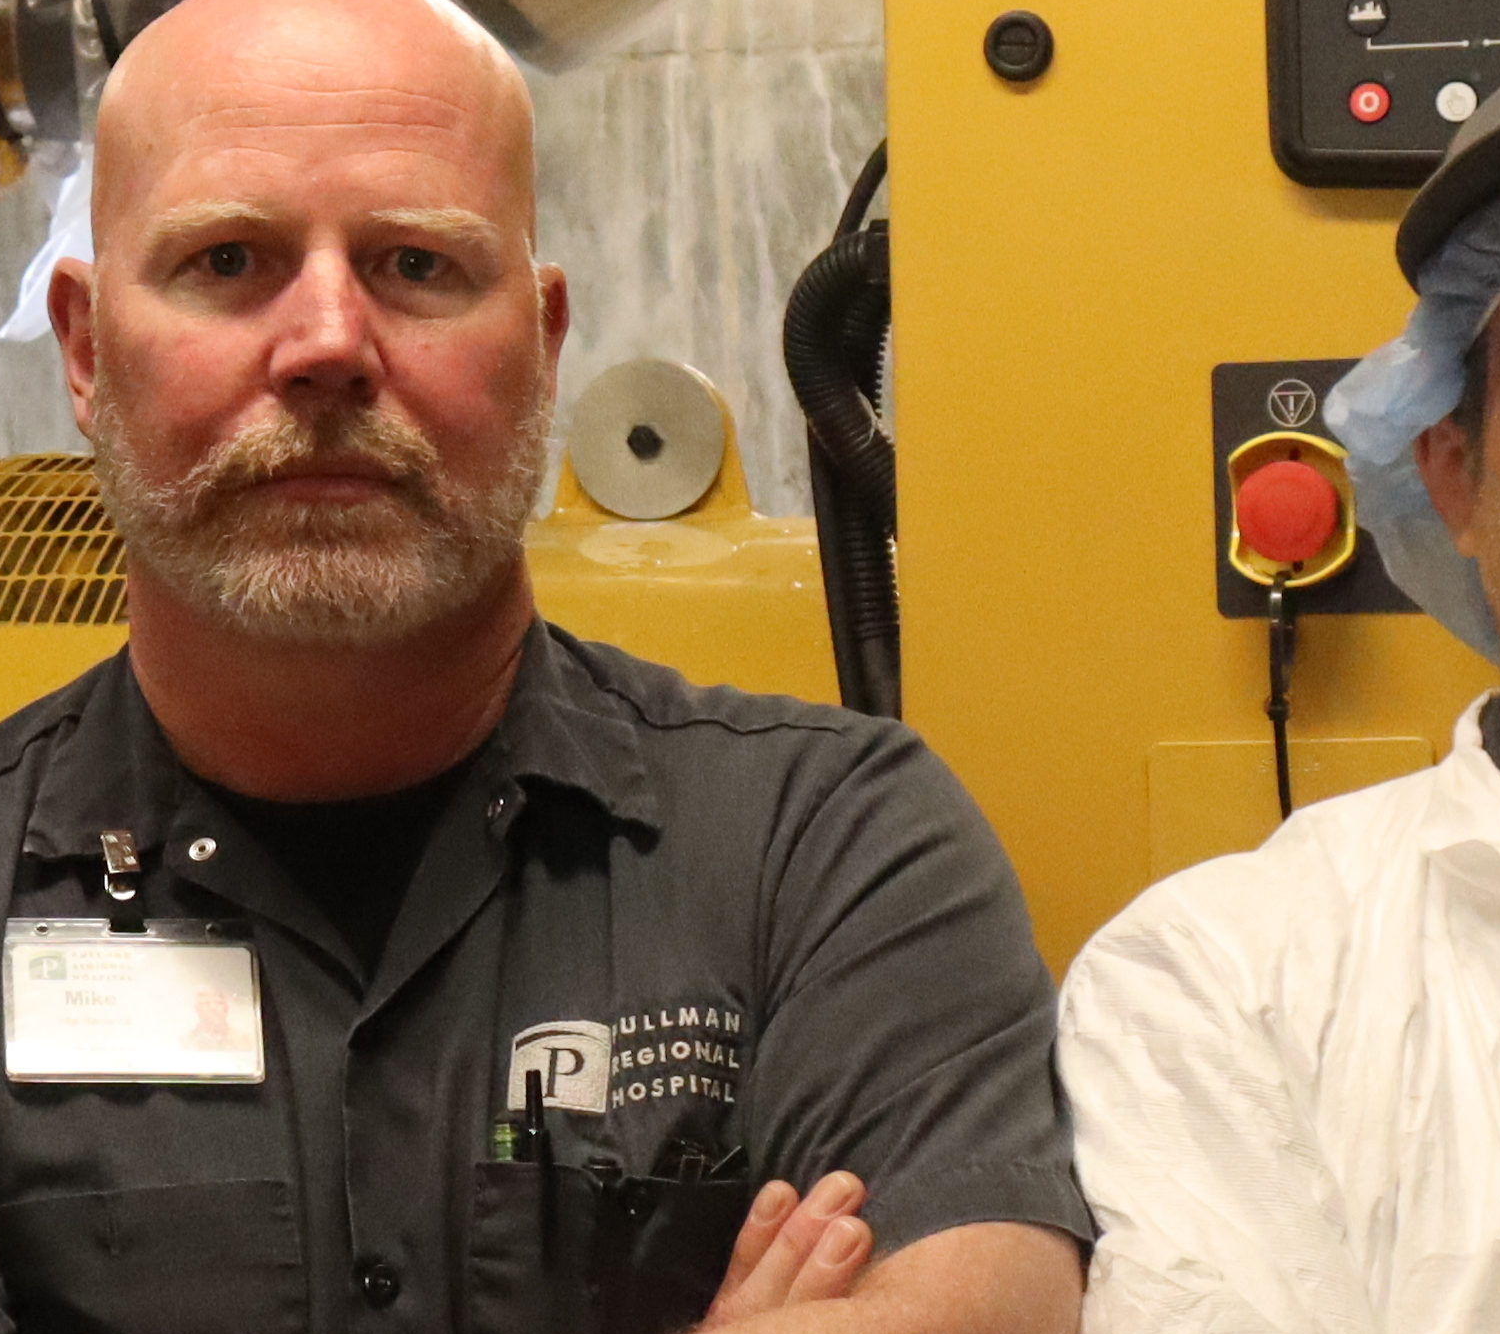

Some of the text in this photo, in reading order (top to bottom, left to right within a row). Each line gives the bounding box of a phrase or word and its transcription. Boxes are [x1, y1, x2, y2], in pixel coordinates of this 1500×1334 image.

[64, 989, 117, 1006] Mike
[543, 1045, 585, 1099] P
[611, 1040, 740, 1076] REGIONAL
[611, 1073, 735, 1109] HOSPITAL
